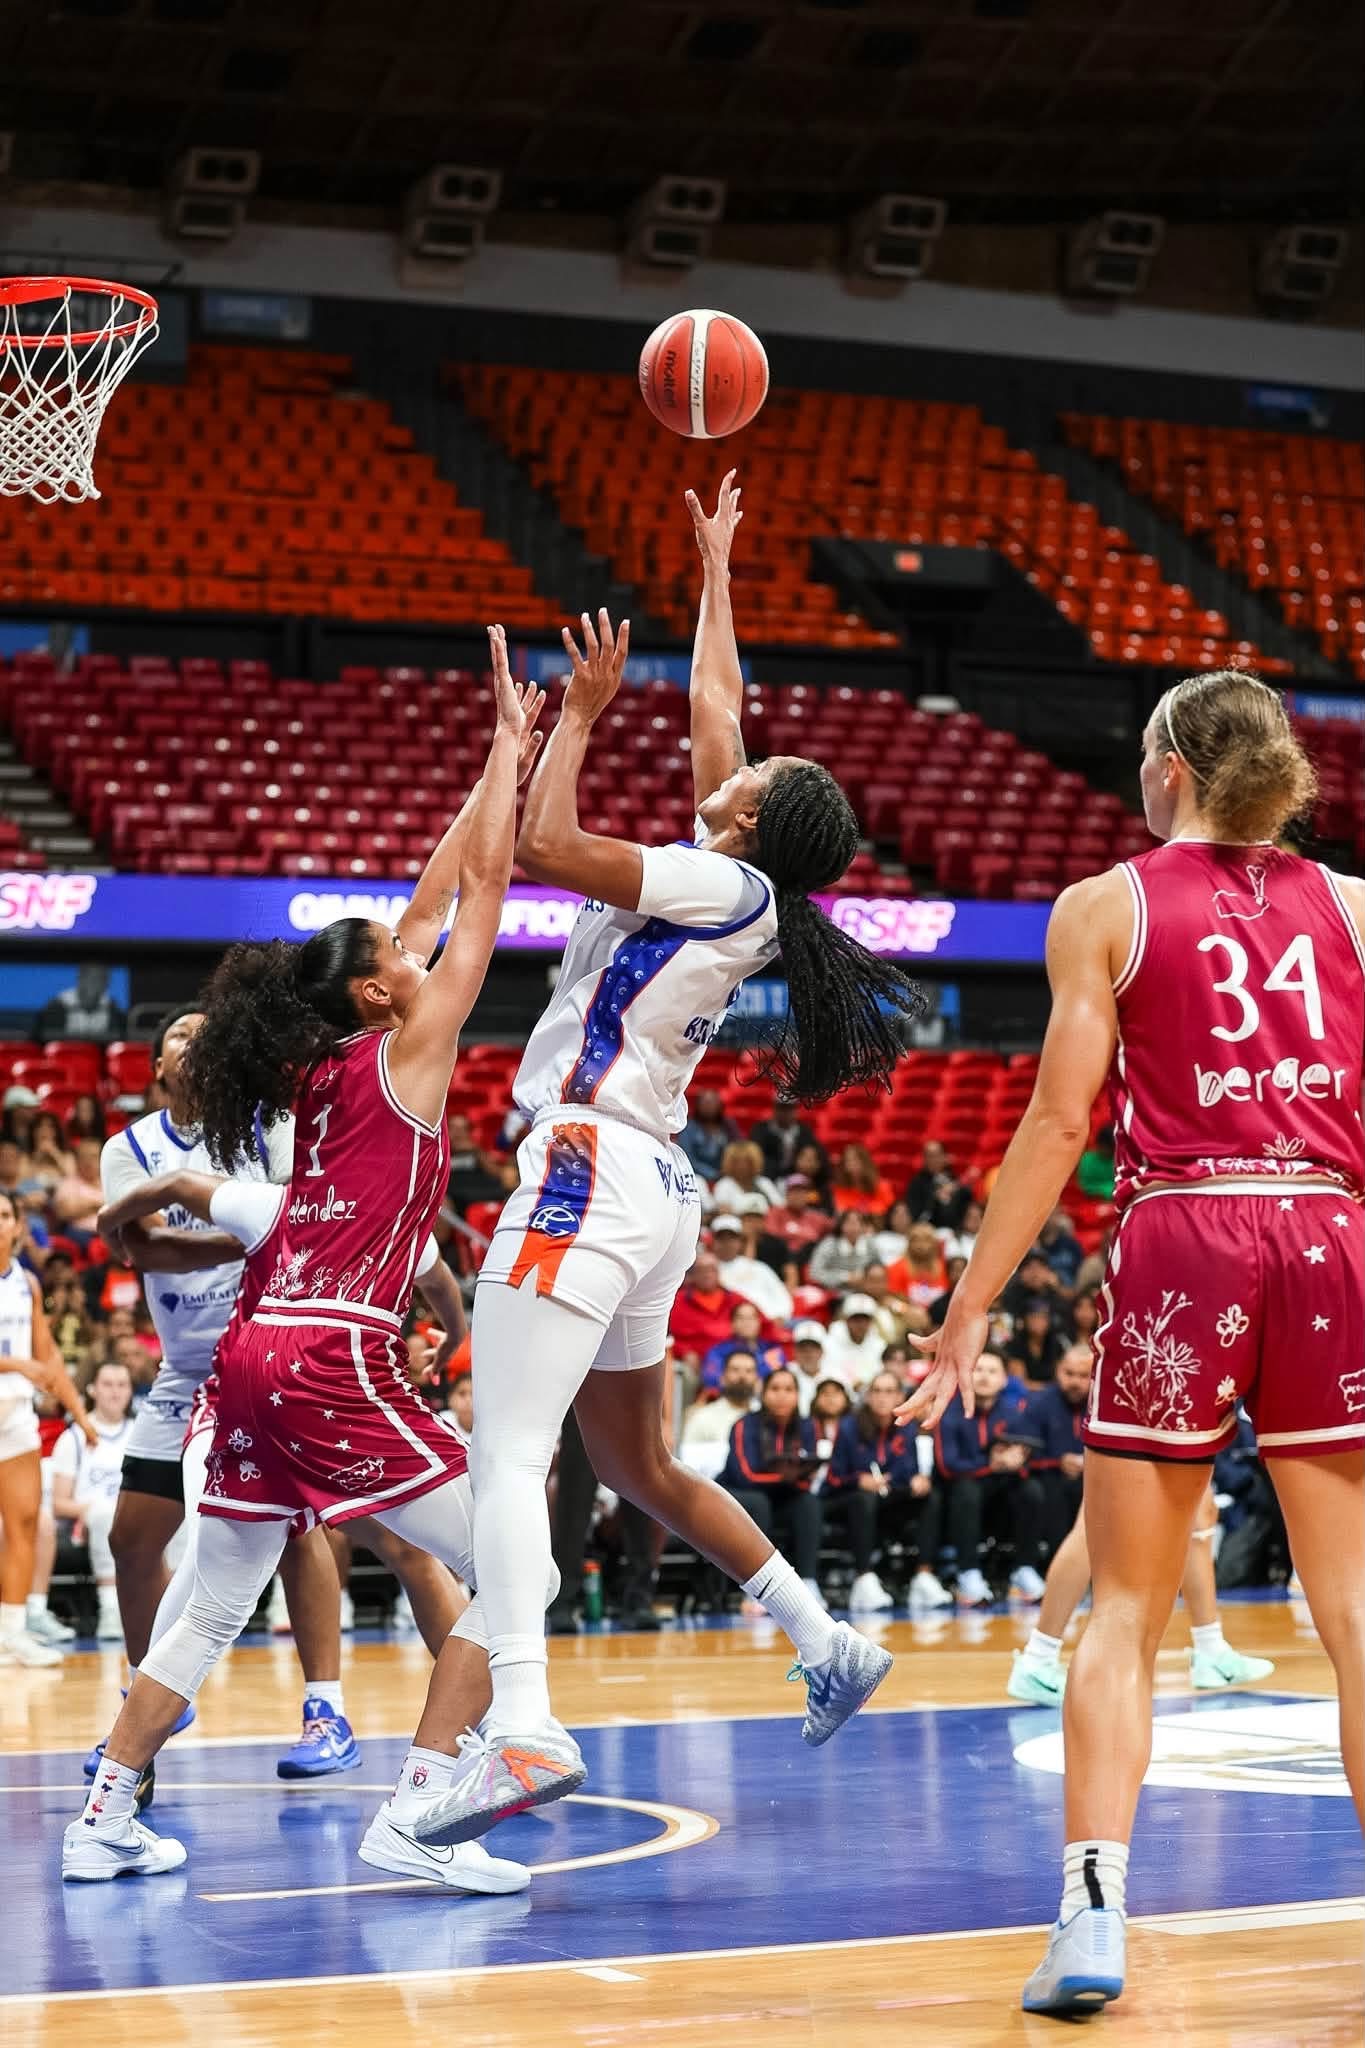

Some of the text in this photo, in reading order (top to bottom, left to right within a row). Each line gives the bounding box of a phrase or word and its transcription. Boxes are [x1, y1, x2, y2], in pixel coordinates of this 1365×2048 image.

[1197, 933, 1326, 1042] 34
[1194, 1057, 1346, 1107] berger
[305, 1103, 333, 1177] 1
[287, 1184, 357, 1225] eléndez
